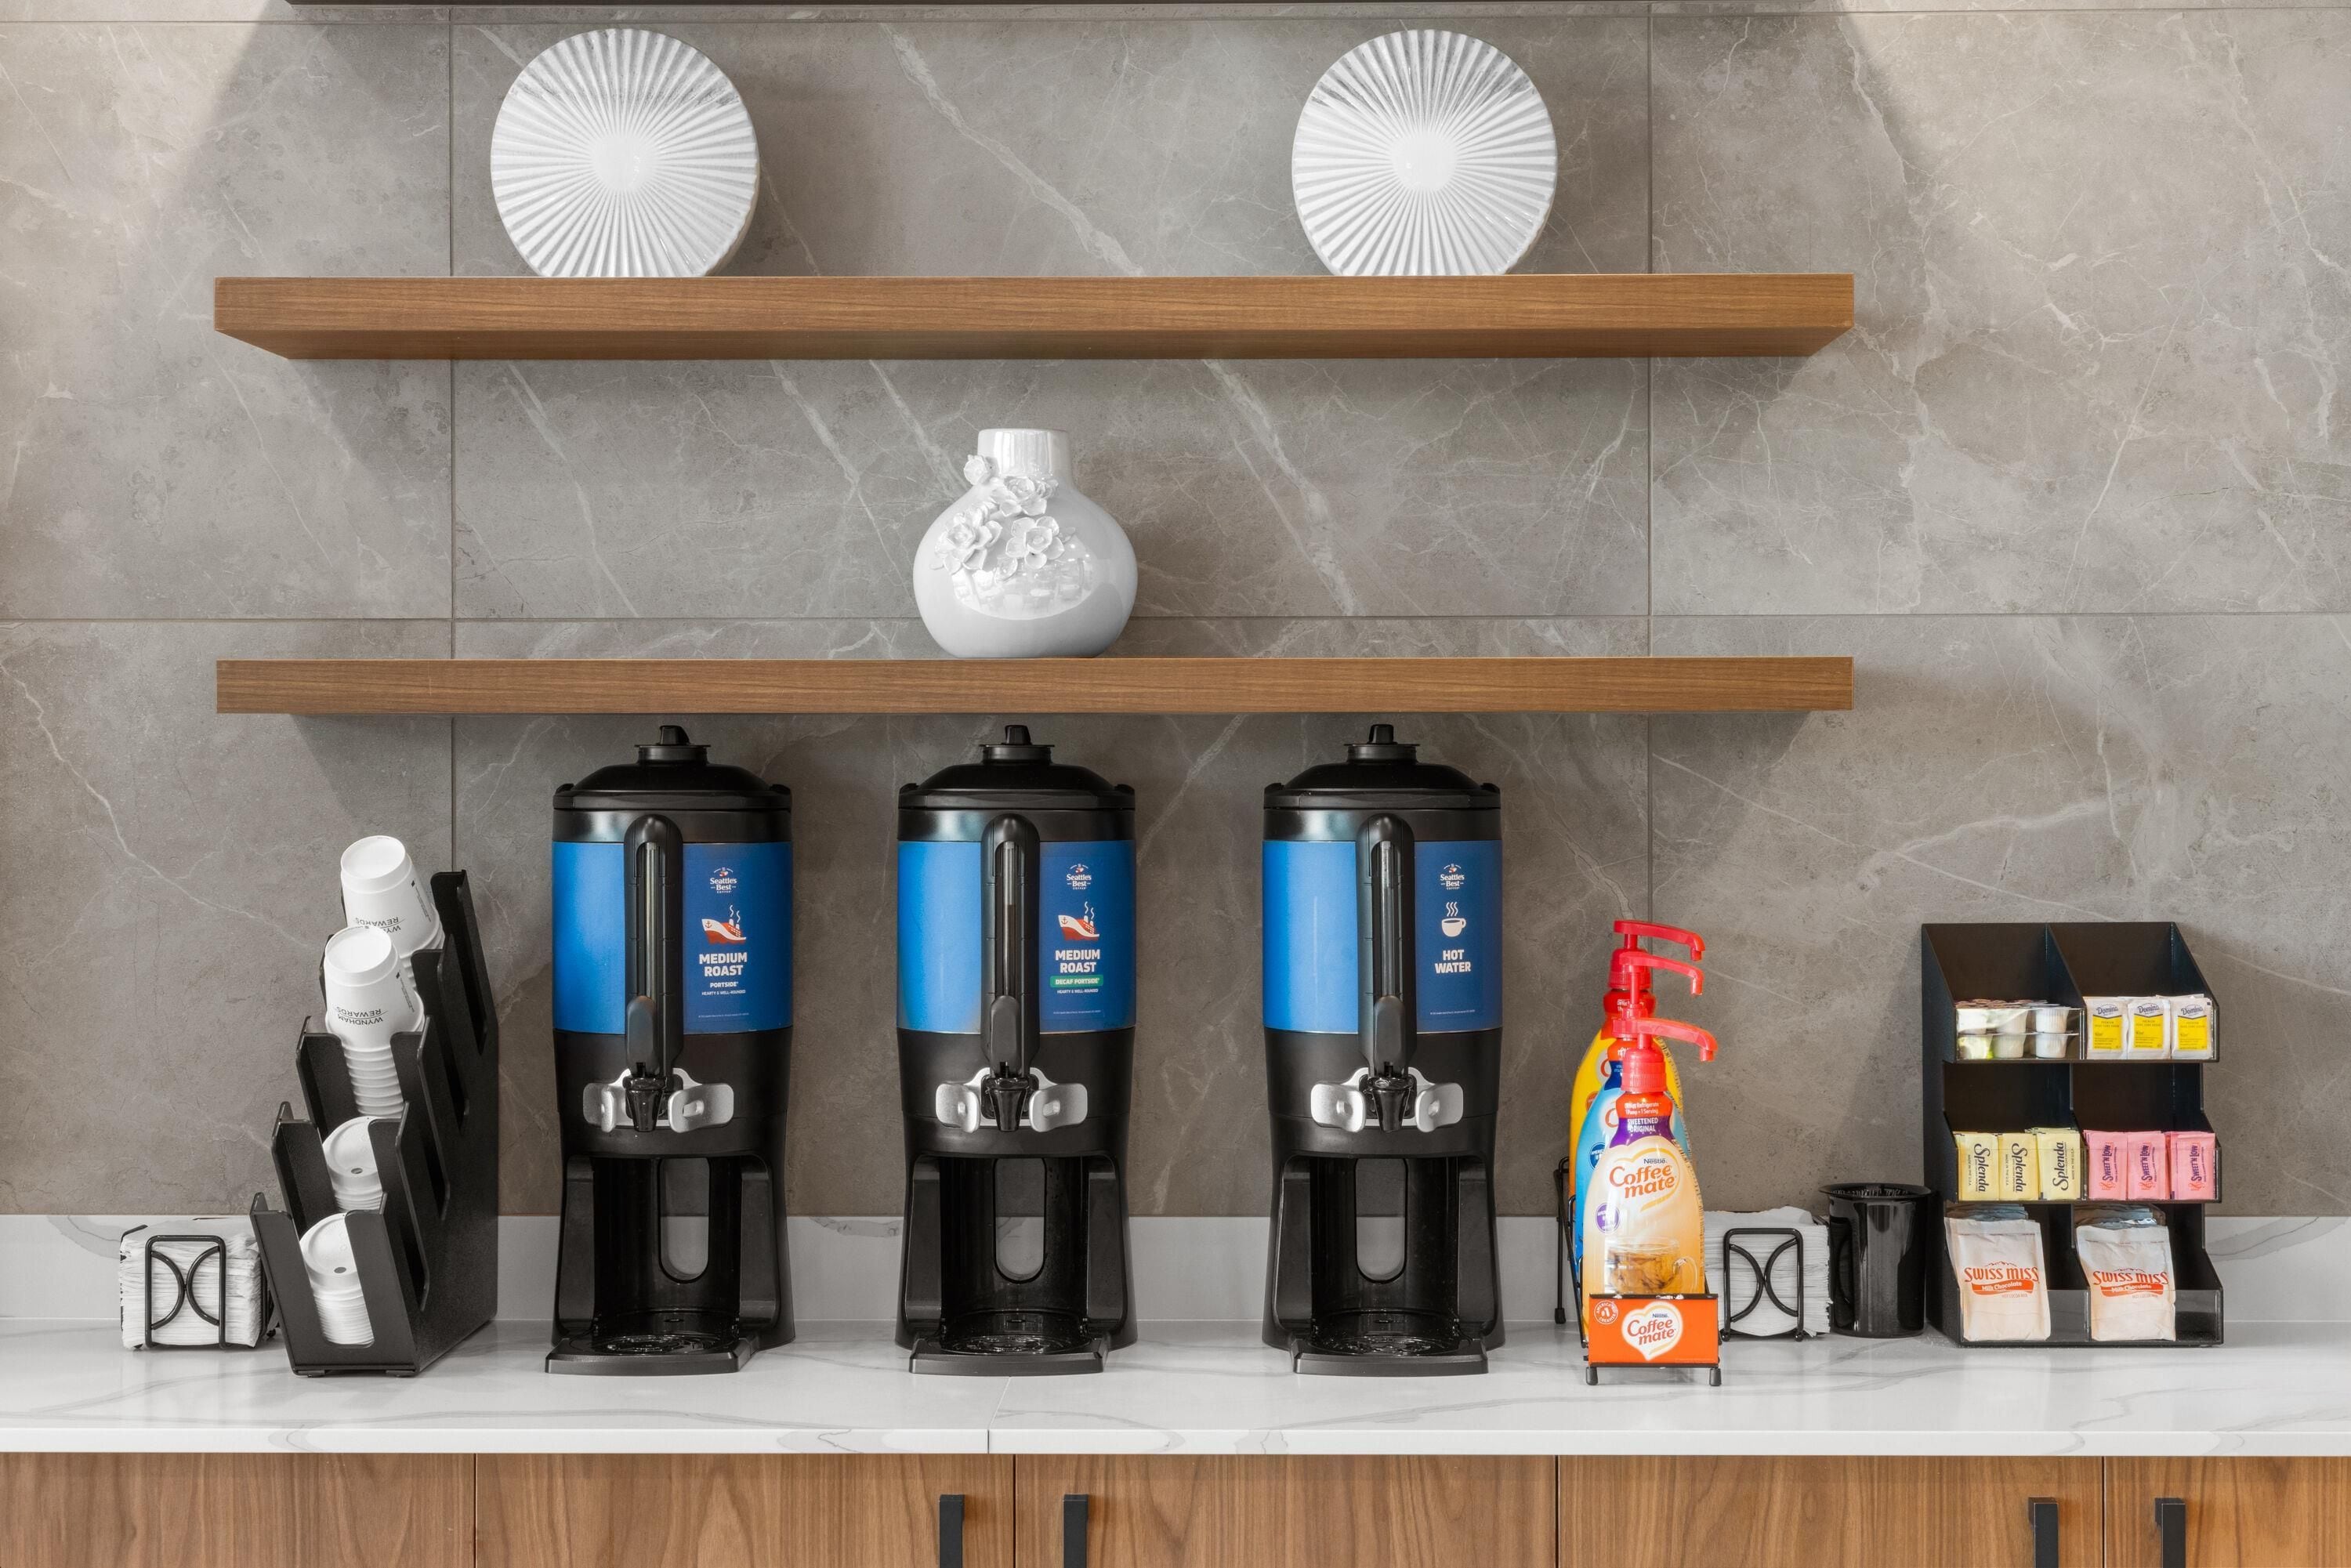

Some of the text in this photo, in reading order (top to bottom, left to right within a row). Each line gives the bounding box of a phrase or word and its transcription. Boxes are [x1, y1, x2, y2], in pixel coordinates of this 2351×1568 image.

[699, 952, 747, 964] MEDIUM
[1055, 949, 1100, 961] MEDIUM
[1443, 950, 1465, 961] HOT
[704, 965, 743, 976] ROAST
[1060, 962, 1096, 973] ROAST
[1435, 961, 1471, 974] WATER
[338, 1014, 382, 1025] WYNDHAM
[1974, 1144, 1991, 1191] Splenda
[2012, 1143, 2027, 1191] Splenda
[2052, 1143, 2069, 1190] Splenda
[1610, 1164, 1672, 1187] Coffee
[1625, 1176, 1675, 1198] mate
[1964, 1268, 2004, 1282] SWISS
[2092, 1271, 2133, 1285] SWISS
[1994, 1281, 2022, 1290] Chocolate
[1627, 1318, 1672, 1337] Coffee
[1639, 1328, 1675, 1345] mate
